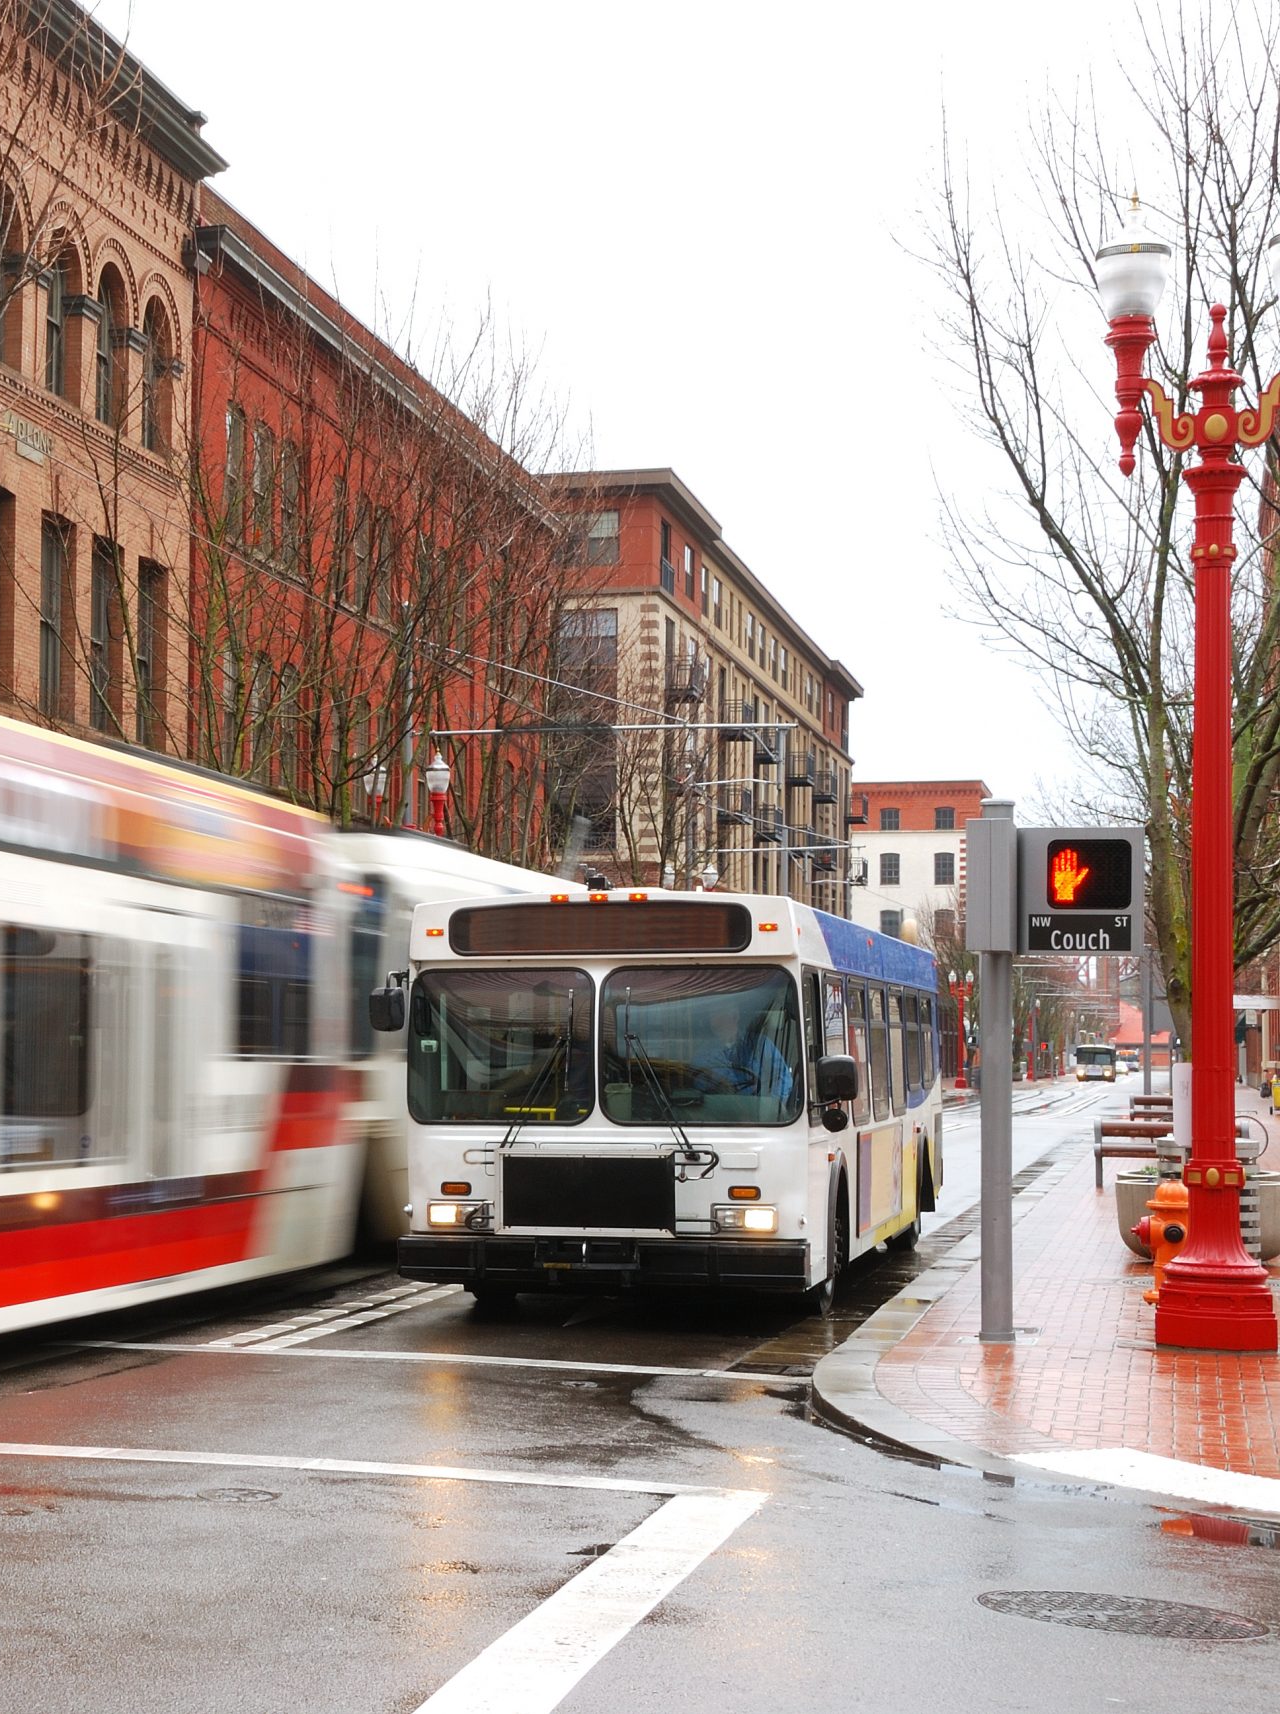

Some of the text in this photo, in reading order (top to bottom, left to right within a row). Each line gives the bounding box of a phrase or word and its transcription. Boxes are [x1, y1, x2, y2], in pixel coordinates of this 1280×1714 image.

[1032, 917, 1128, 927] NW ST
[1050, 929, 1110, 950] Couch
